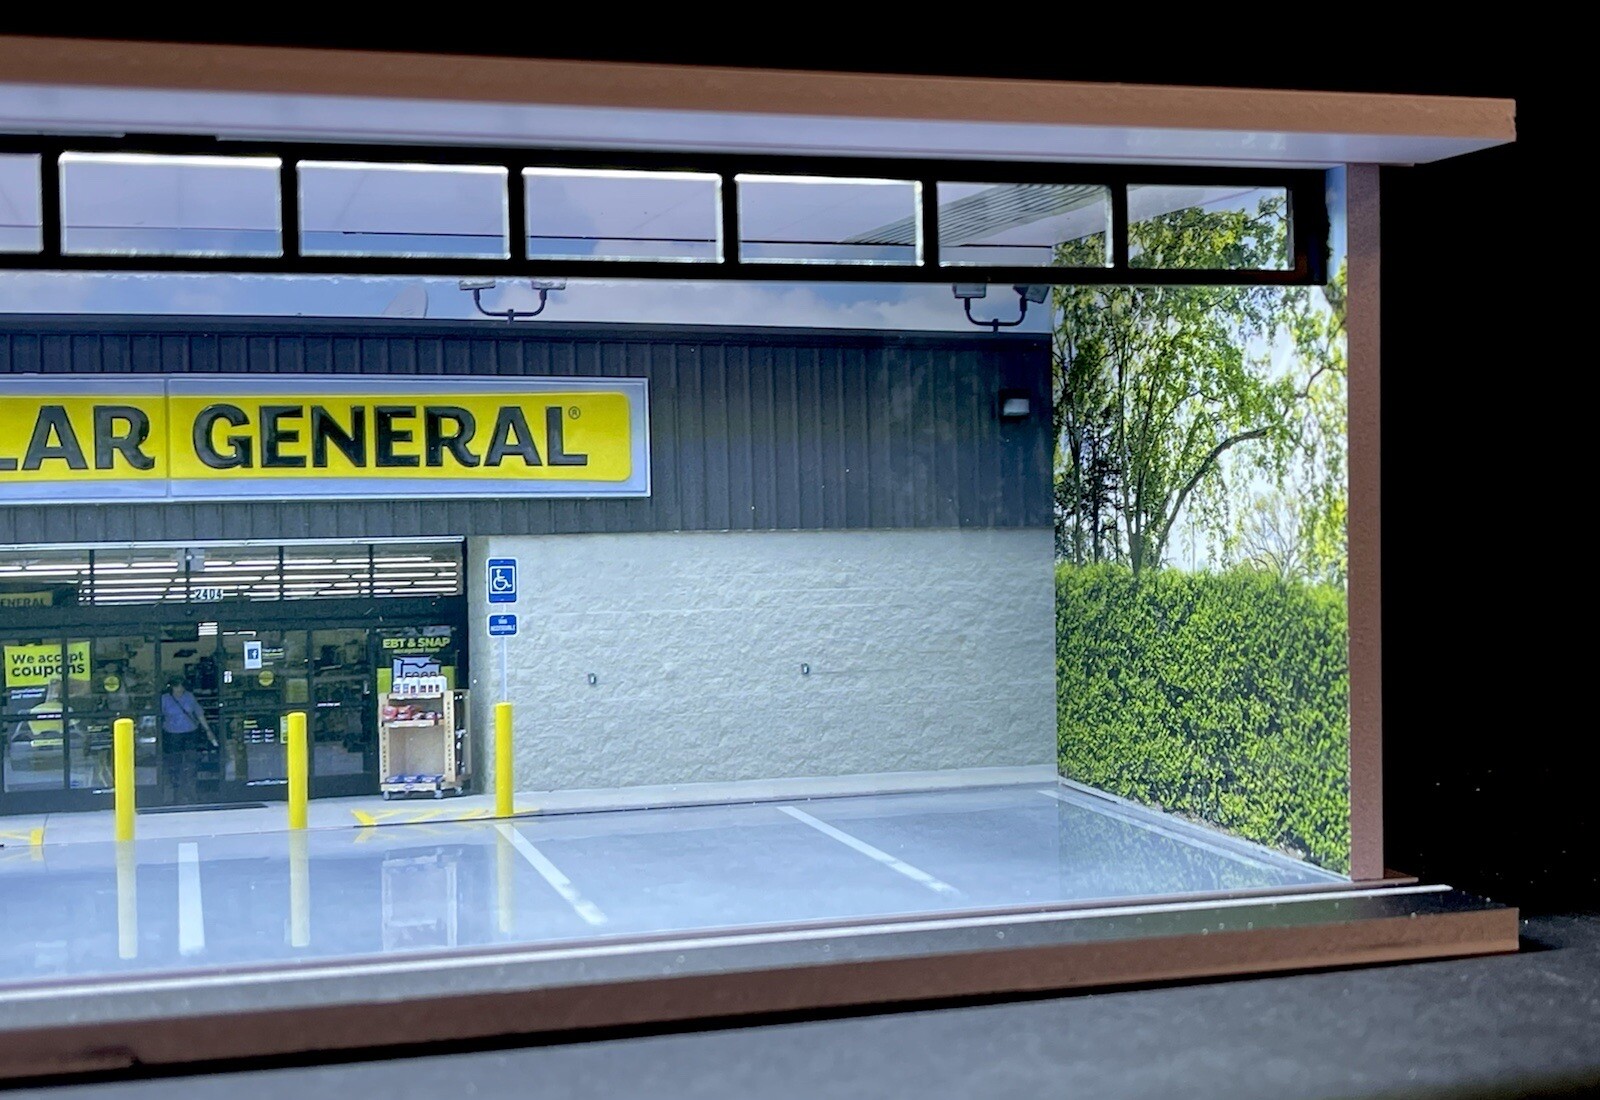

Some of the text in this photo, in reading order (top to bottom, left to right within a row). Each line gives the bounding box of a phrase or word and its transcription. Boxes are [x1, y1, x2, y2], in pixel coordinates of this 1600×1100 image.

[383, 637, 450, 648] EBT & SNAP
[11, 651, 84, 665] We accpt
